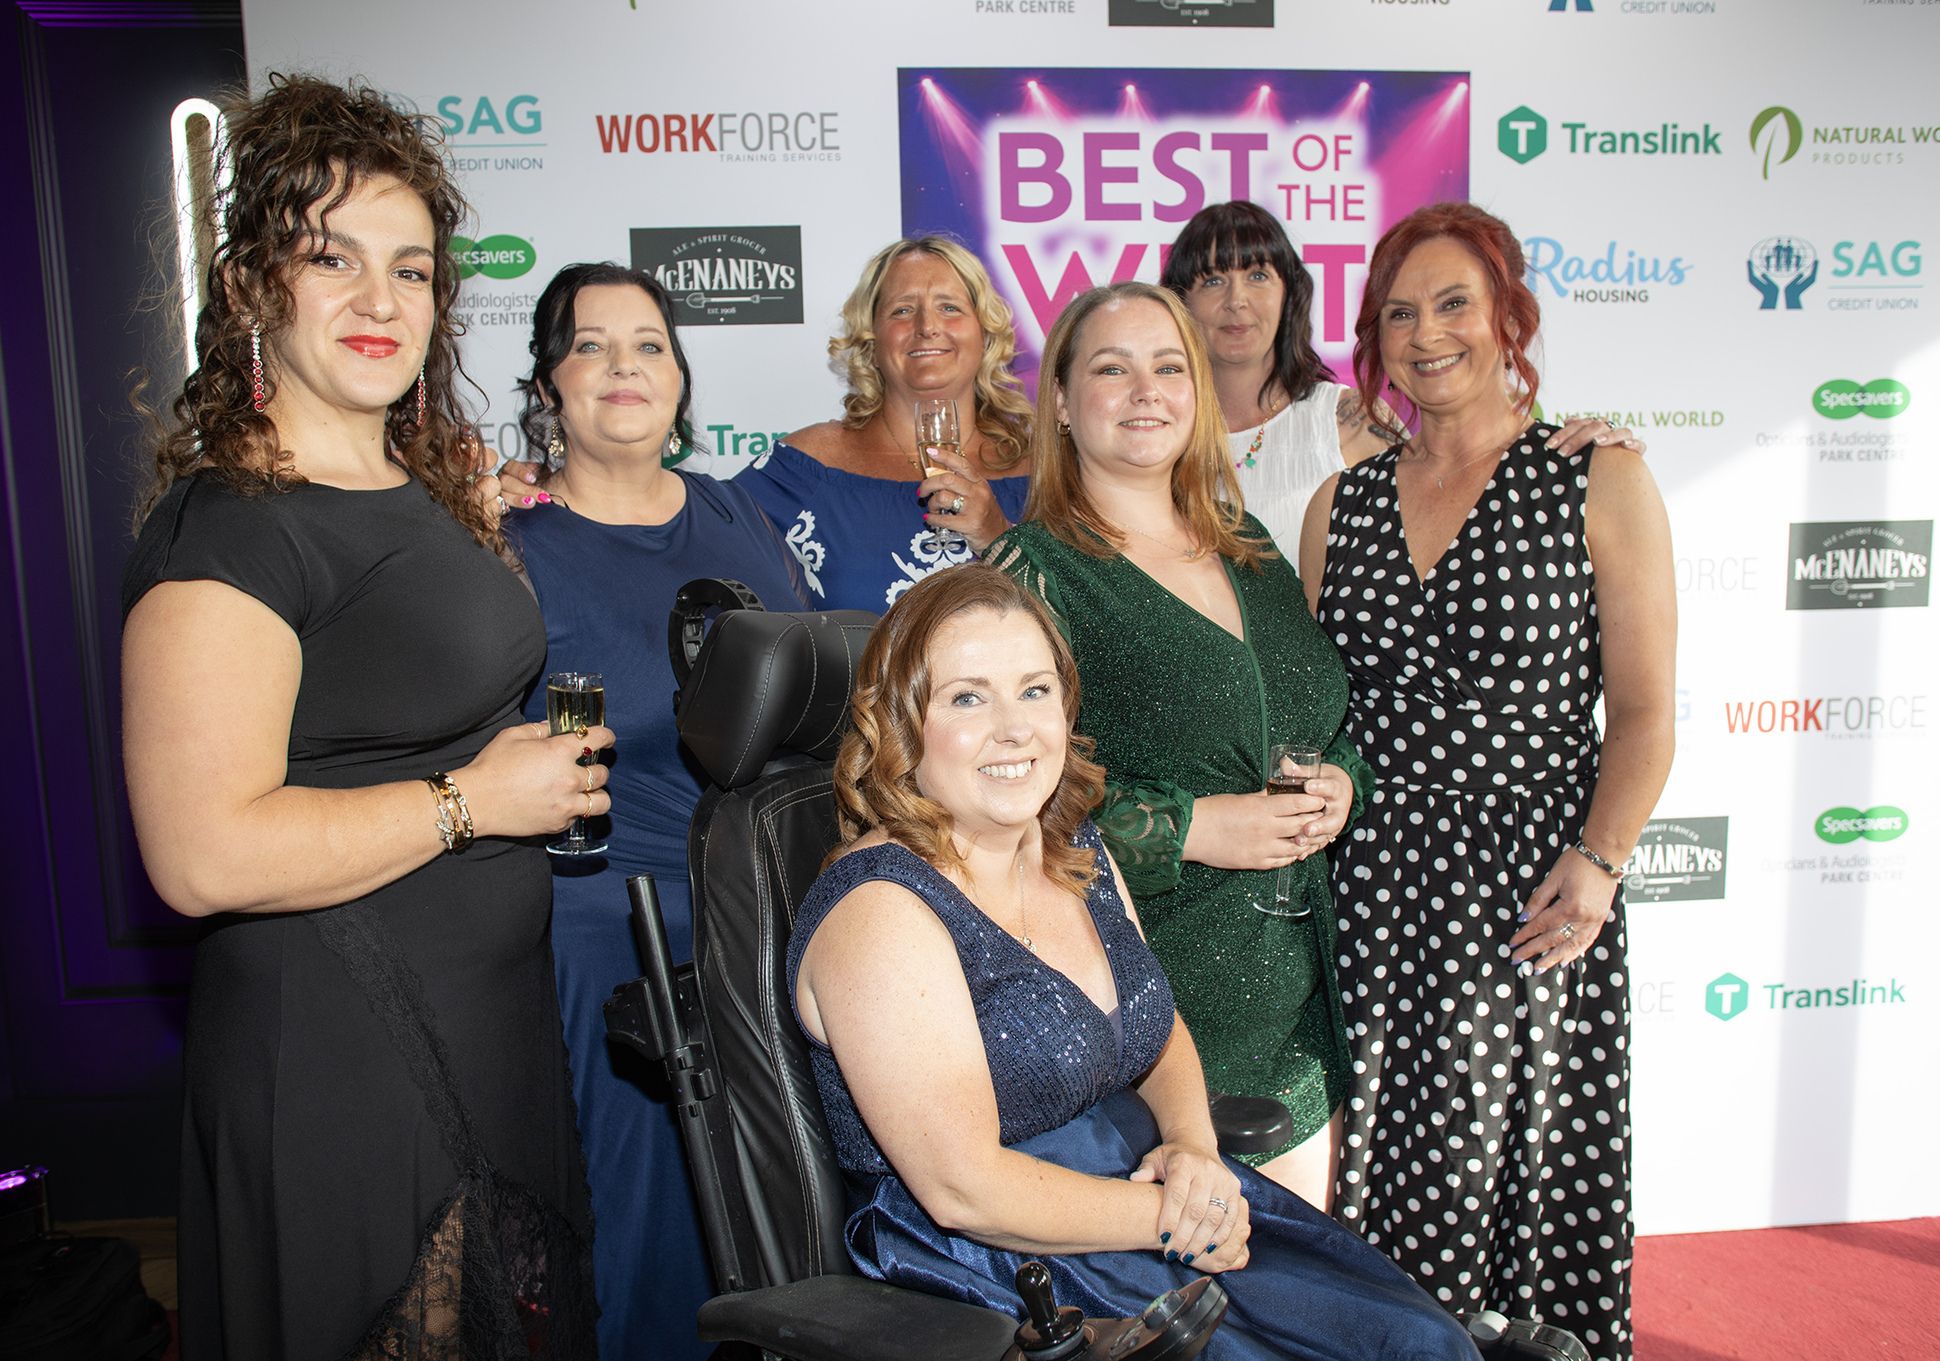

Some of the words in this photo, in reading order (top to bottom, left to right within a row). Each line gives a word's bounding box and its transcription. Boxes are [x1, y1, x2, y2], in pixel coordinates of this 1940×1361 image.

[976, 0, 1015, 13] PARK
[1020, 0, 1075, 13] CENTRE
[1620, 1, 1666, 13] CREDIT
[1670, 1, 1715, 13] UNION
[437, 95, 542, 135] SAG
[595, 112, 840, 153] WORKFORCE
[1562, 123, 1722, 154] Translink
[1813, 127, 1906, 144] NATURAL
[719, 153, 776, 163] TRAINING
[783, 153, 842, 162] SERVICES
[1292, 134, 1352, 172] OF
[1812, 152, 1904, 165] PRODUCTS
[494, 157, 543, 171] UNION
[999, 131, 1268, 223] BEST
[1277, 184, 1365, 222] THE
[671, 241, 689, 256] ALE
[698, 234, 727, 244] SPIRIT
[730, 235, 767, 255] GROCER
[1524, 236, 1695, 298] Radius
[1831, 240, 1922, 277] SAG
[1574, 289, 1649, 303] HOUSING
[1827, 298, 1872, 311] CREDIT
[1875, 297, 1919, 311] UNION
[1820, 389, 1904, 410] Specsavers
[1652, 410, 1725, 427] WORLD
[1819, 450, 1854, 463] PARK
[1725, 695, 1927, 734] WORKFORCE
[1822, 816, 1902, 836] Specsavers
[1821, 871, 1853, 884] PARK
[1763, 978, 1906, 1009] Translink
